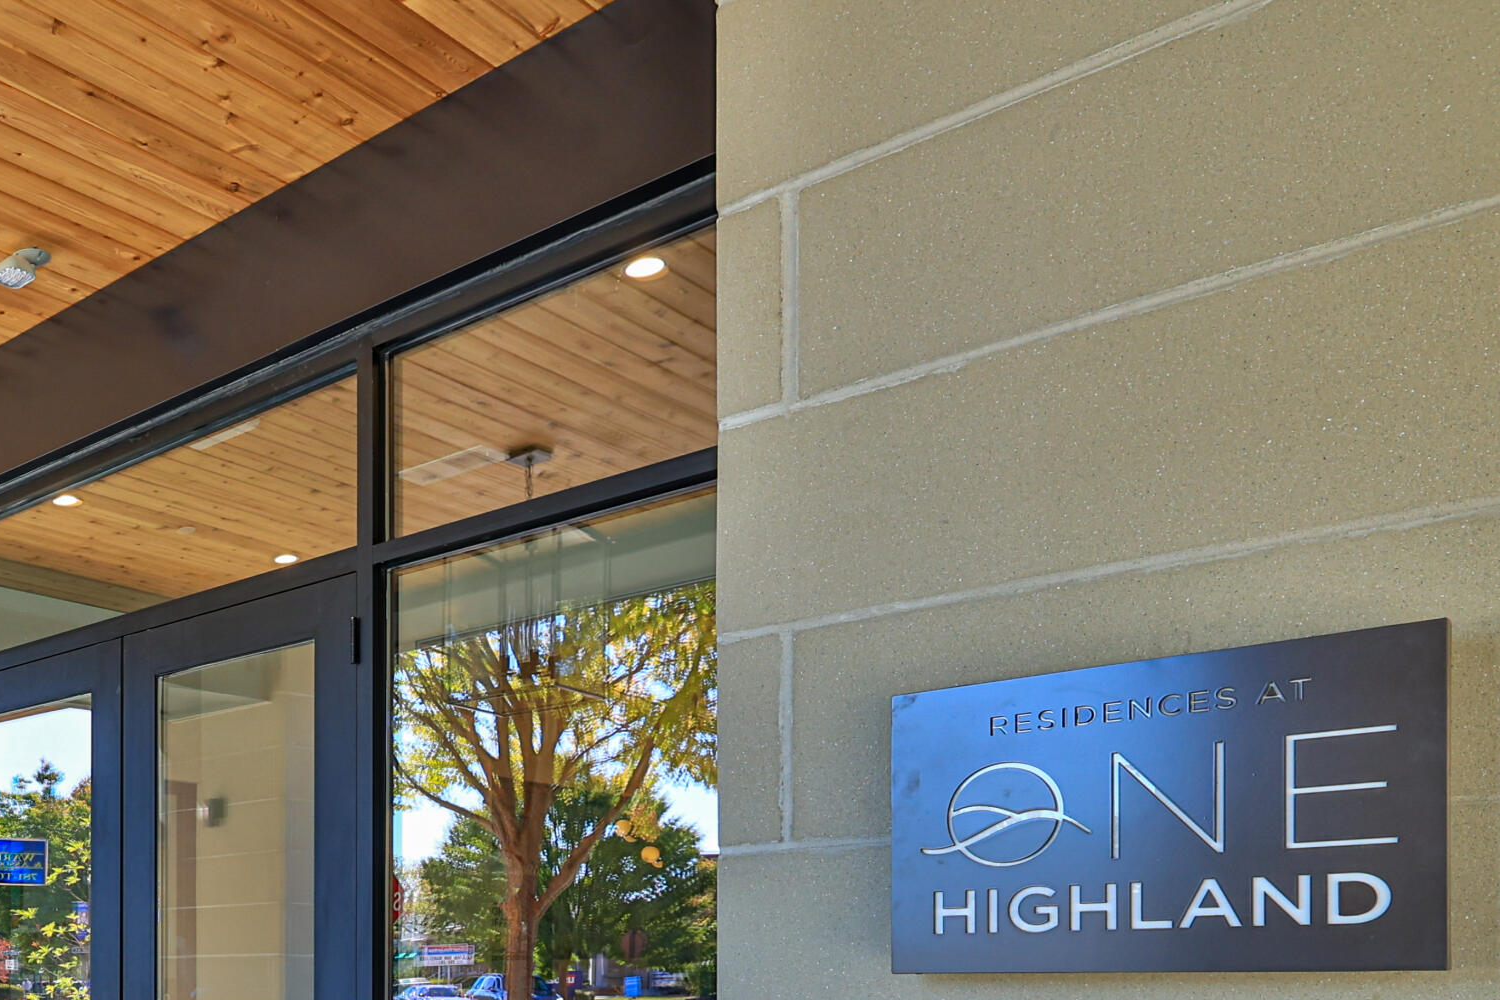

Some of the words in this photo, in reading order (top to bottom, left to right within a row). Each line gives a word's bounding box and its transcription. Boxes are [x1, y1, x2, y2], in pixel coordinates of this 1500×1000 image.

[989, 685, 1237, 737] RESIDENCES
[1255, 676, 1312, 705] AT
[920, 723, 1398, 867] ONE
[932, 871, 1393, 935] HIGHLAND
